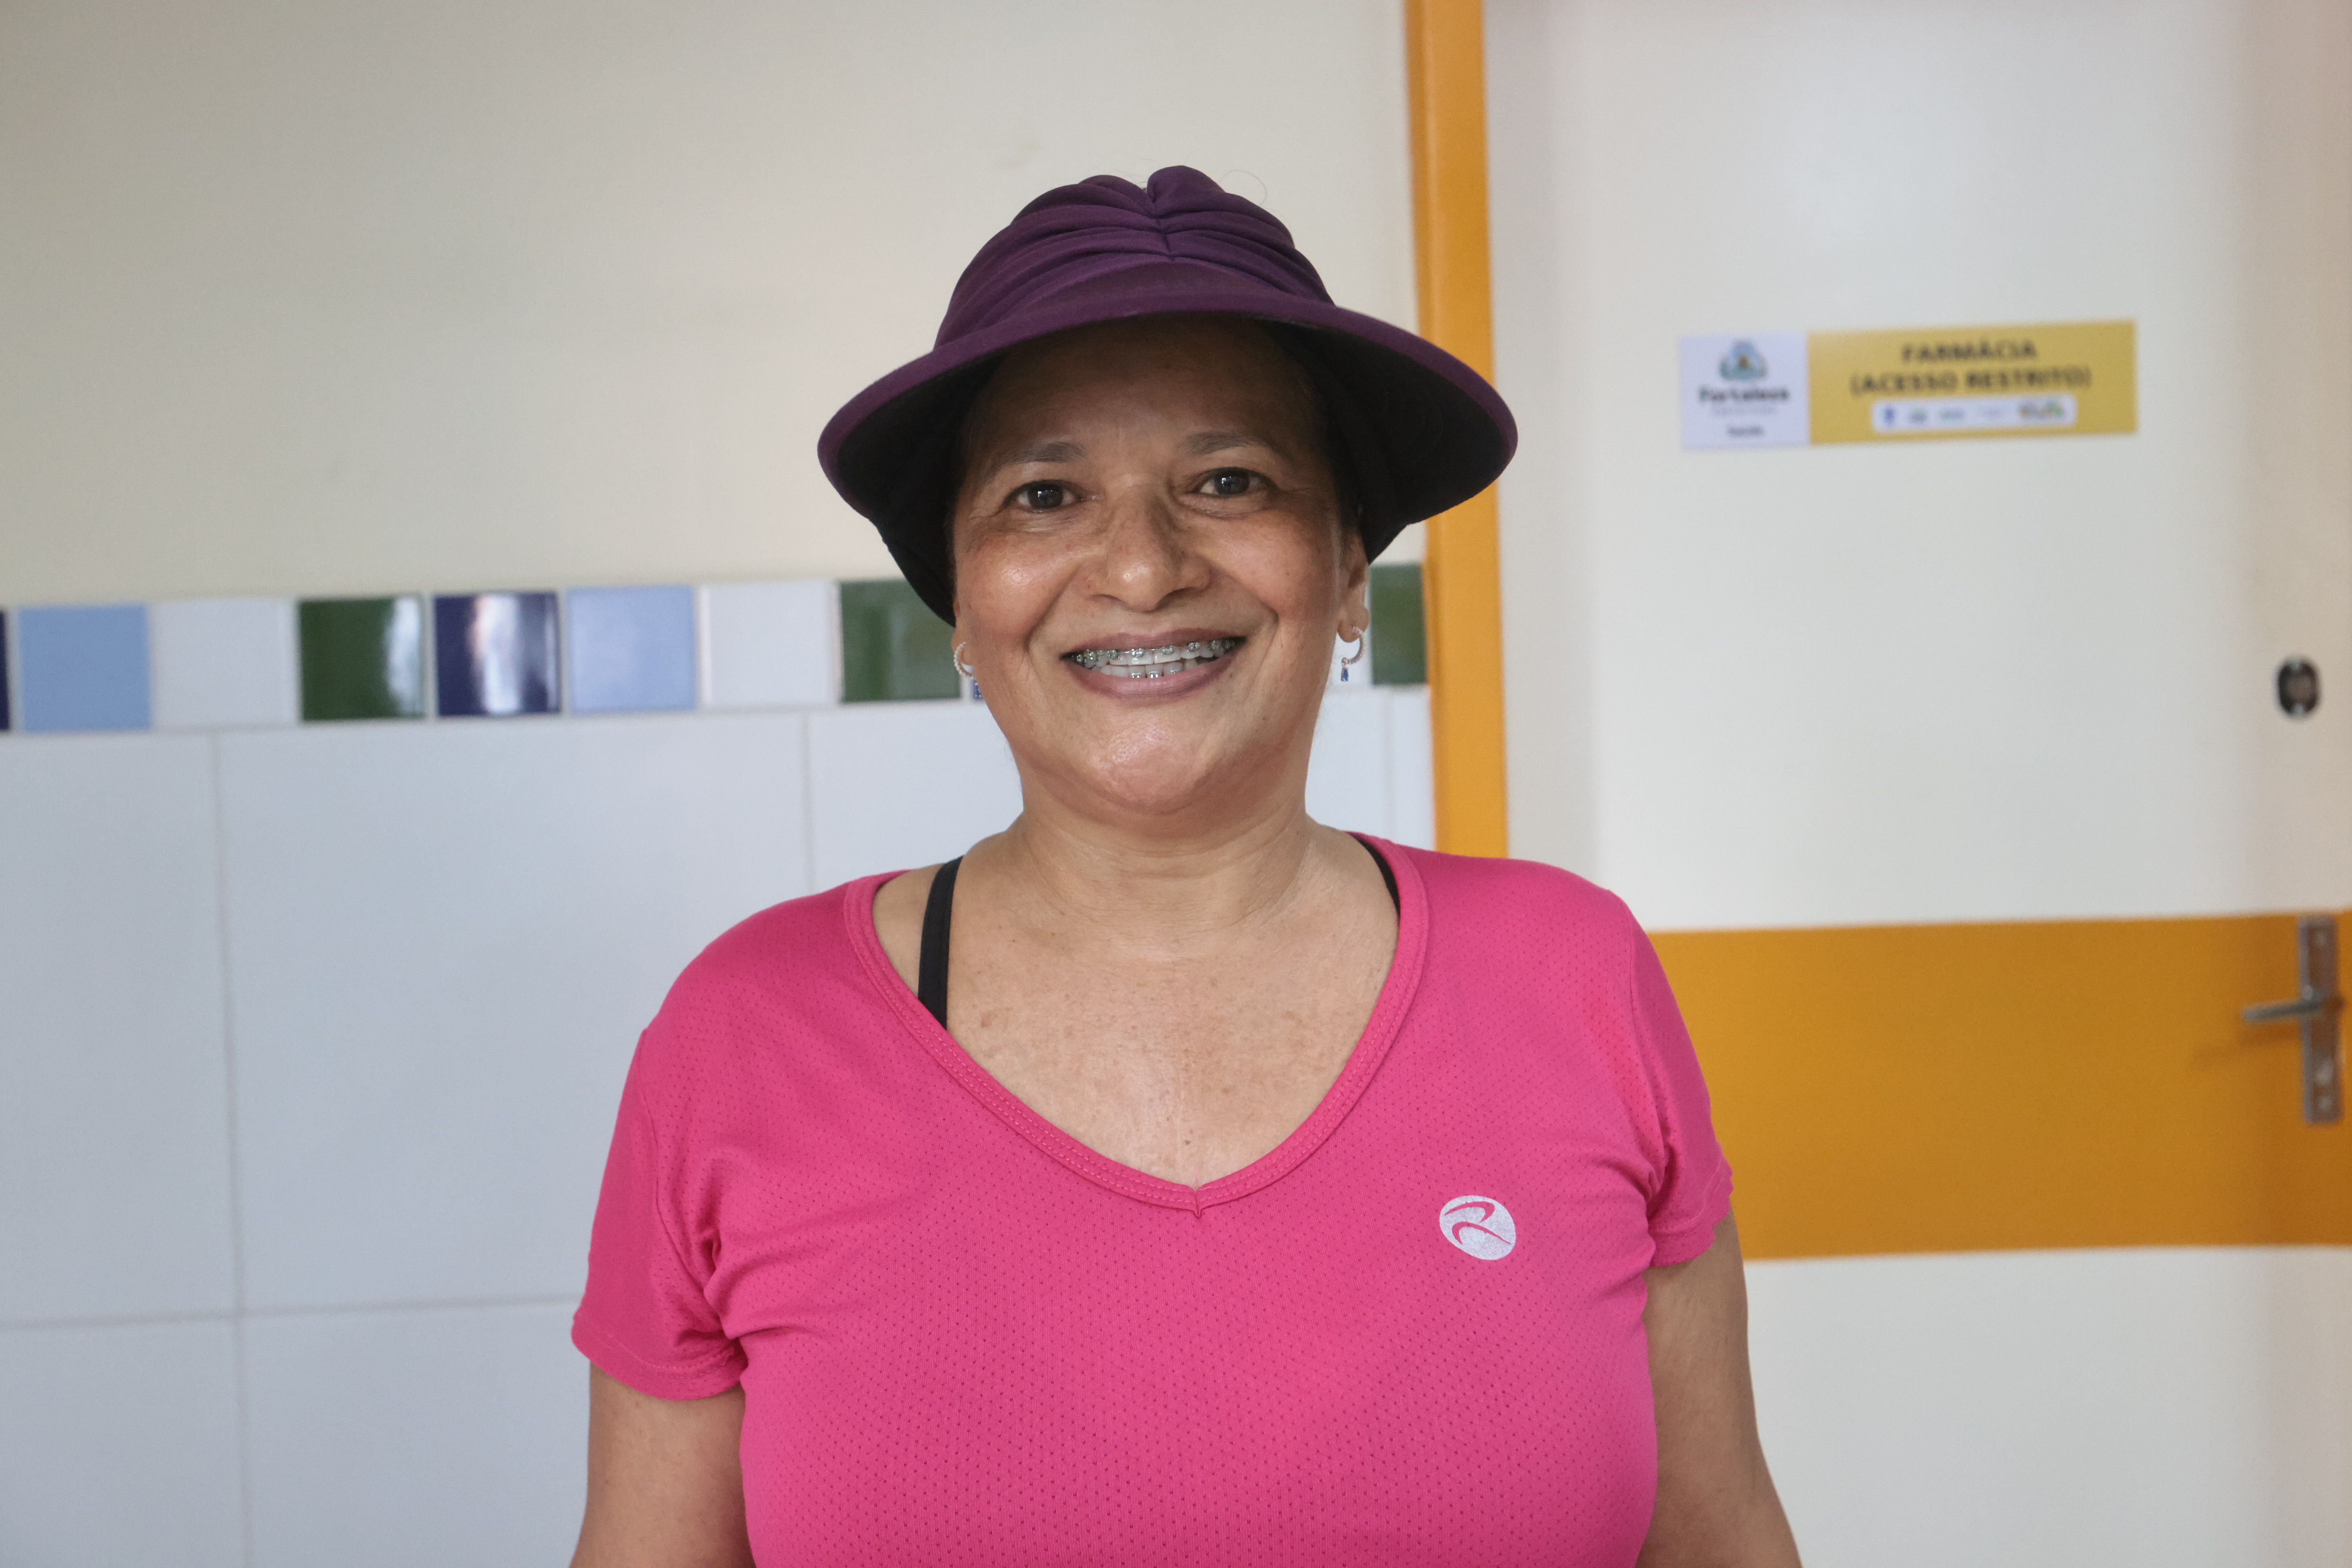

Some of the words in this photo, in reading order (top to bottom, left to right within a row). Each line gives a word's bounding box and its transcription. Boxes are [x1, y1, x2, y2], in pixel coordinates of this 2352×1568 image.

[1902, 339, 2037, 362] FARMÁCIA
[1851, 373, 1958, 397] (ACESSO
[1965, 366, 2092, 390] RESTRITO)
